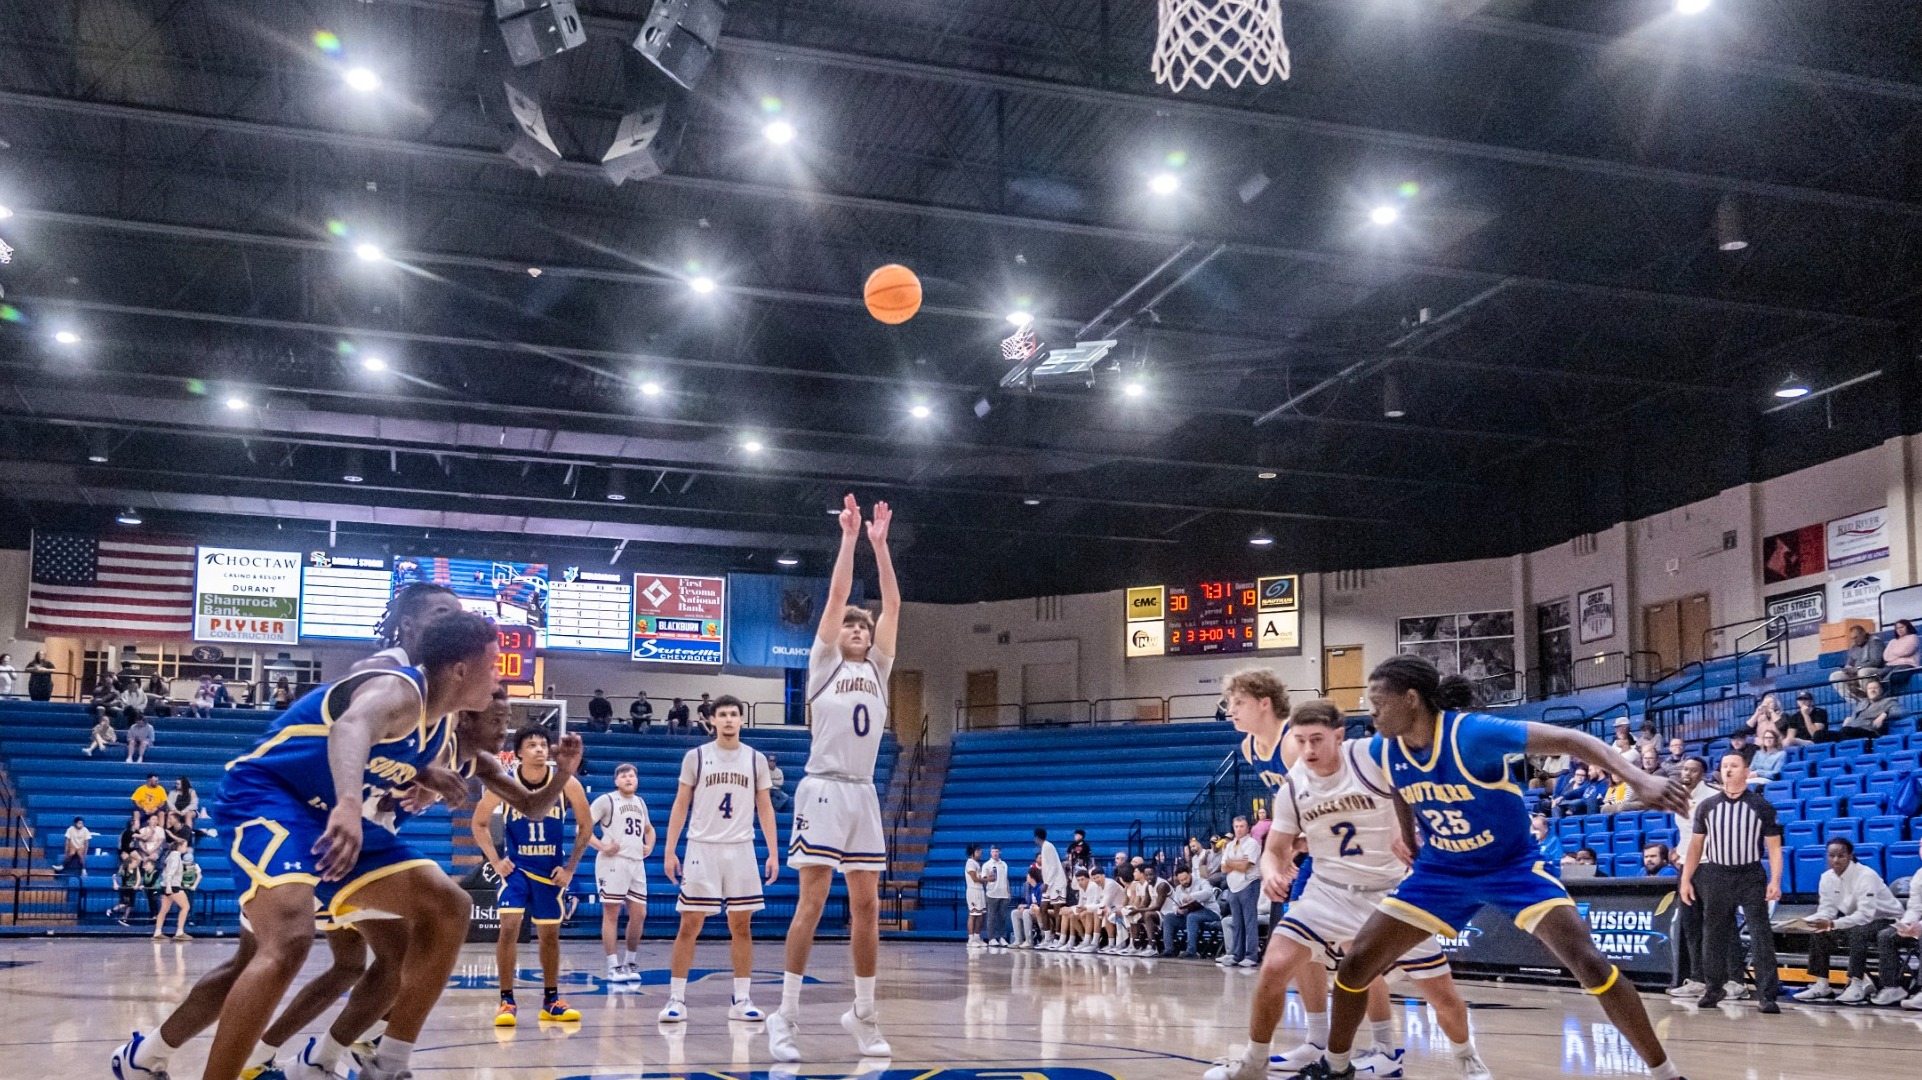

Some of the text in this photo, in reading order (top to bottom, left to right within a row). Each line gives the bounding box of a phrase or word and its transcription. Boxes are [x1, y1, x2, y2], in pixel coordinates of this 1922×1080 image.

[213, 553, 296, 569] CHOCTAW
[232, 585, 275, 593] DURANT
[679, 578, 702, 588] First
[1201, 583, 1231, 598] 7:31
[679, 587, 716, 597] Texoma
[679, 594, 720, 605] National
[1242, 590, 1256, 606] 19
[204, 594, 278, 608] Shamrock
[678, 602, 705, 613] Bank
[1170, 595, 1188, 611] 30
[1773, 598, 1817, 615] LOST STREET
[203, 605, 241, 616] Bank
[1228, 604, 1233, 615] 1
[210, 618, 284, 634] PLYLER
[658, 620, 700, 632] BLACKBURN
[209, 630, 284, 641] CONSTRUCTION
[1172, 631, 1181, 643] 2
[1187, 630, 1195, 642] 3
[1227, 628, 1236, 639] 4
[1245, 626, 1253, 639] 6
[634, 639, 721, 657] Stuteville
[660, 653, 719, 662] CHEVROLET
[852, 703, 870, 737] 0
[705, 772, 749, 789] SAVAGE STORM
[718, 792, 733, 819] 4
[625, 817, 642, 837] 35
[1421, 809, 1471, 836] 25
[528, 822, 546, 842] 11
[1330, 821, 1364, 858] 2
[1589, 911, 1653, 931] VISION
[1590, 933, 1651, 955] BANK
